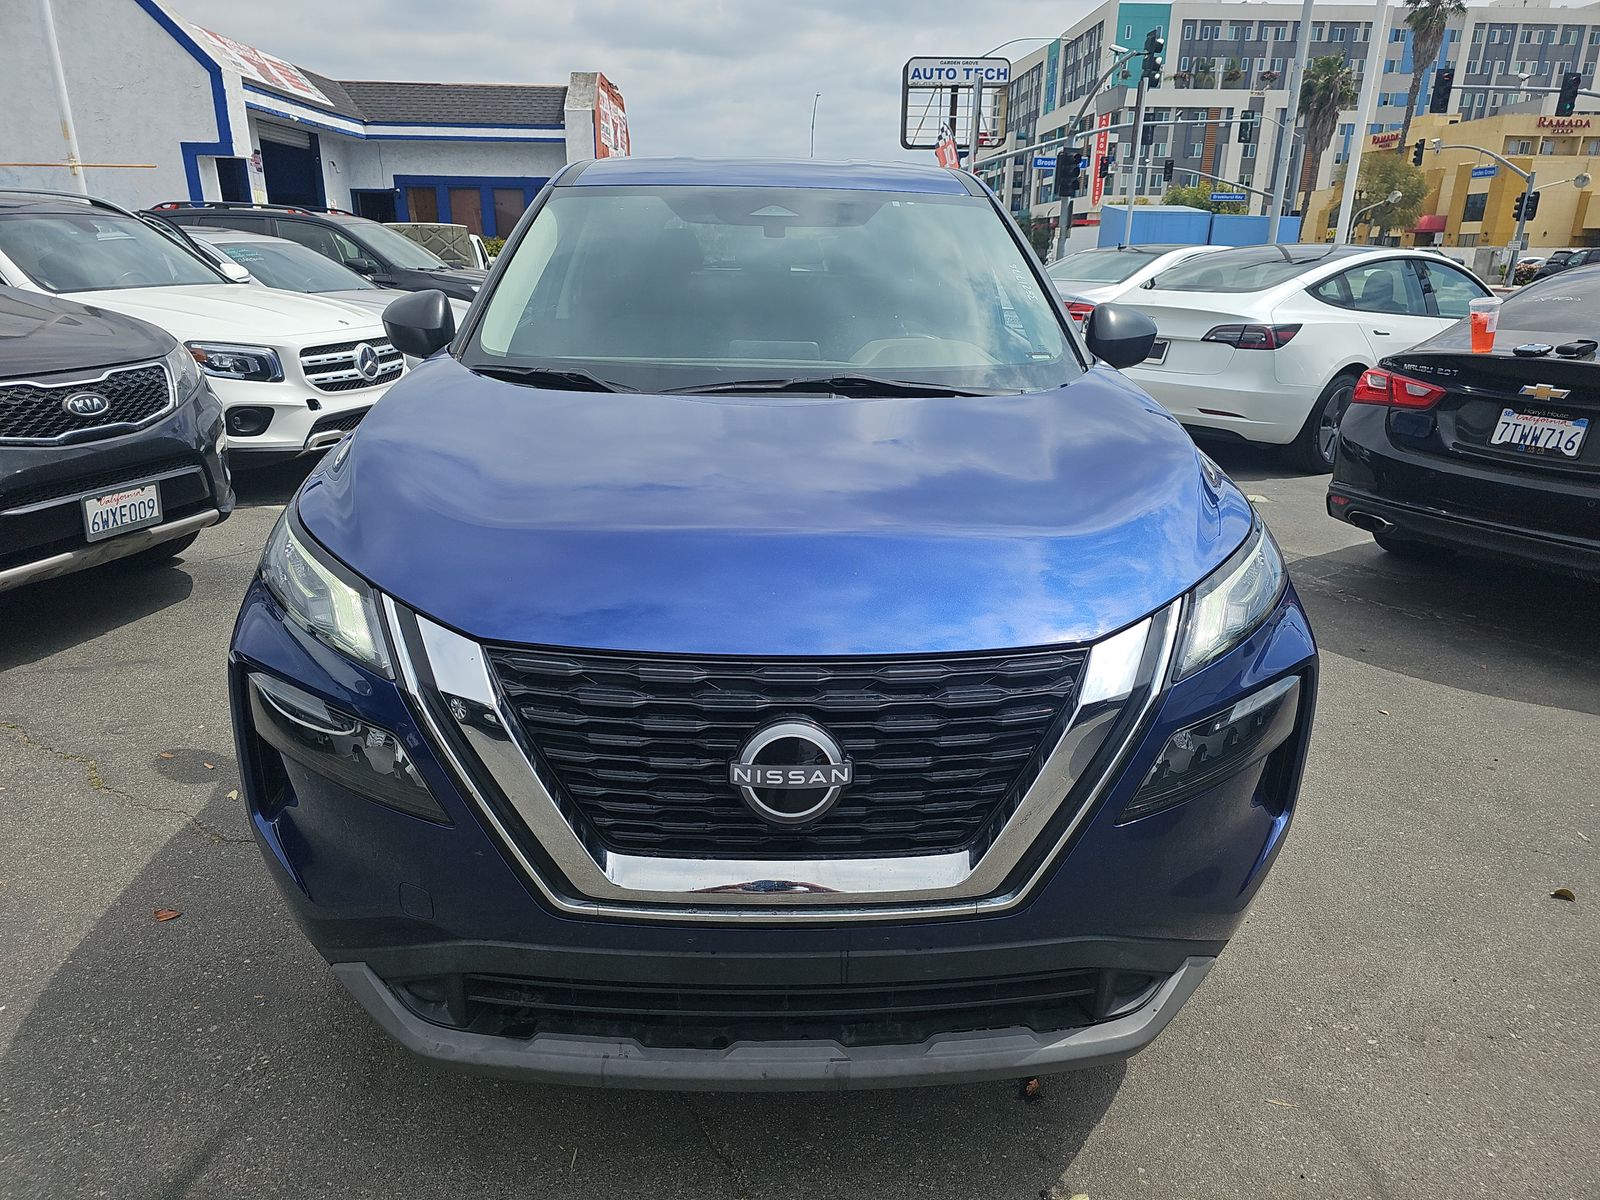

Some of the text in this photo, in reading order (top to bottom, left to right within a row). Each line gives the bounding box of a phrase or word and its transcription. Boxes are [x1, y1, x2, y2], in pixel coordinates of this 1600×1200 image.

[911, 67, 957, 80] AUTO
[73, 398, 104, 412] KIA
[1516, 413, 1572, 427] California
[1498, 421, 1581, 451] 7TWW716
[99, 490, 145, 506] California
[91, 498, 155, 533] 6WXE009
[734, 767, 849, 785] NISSAN
